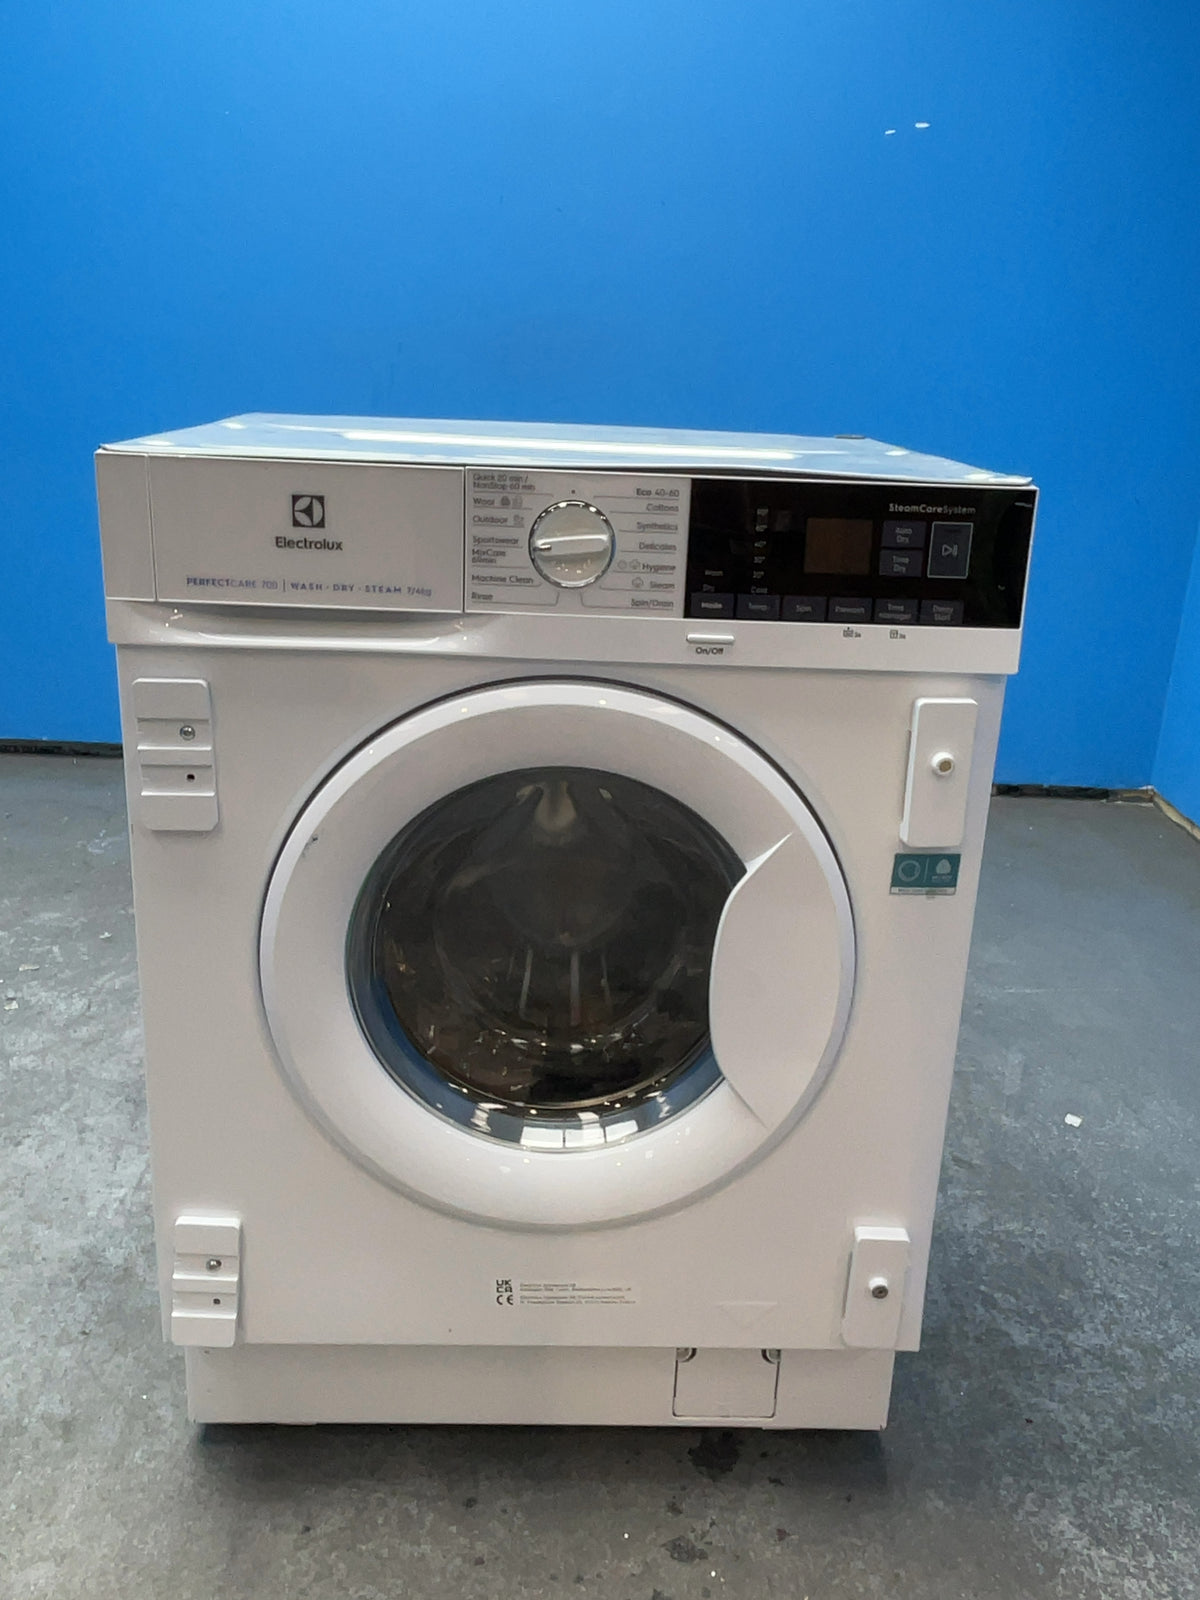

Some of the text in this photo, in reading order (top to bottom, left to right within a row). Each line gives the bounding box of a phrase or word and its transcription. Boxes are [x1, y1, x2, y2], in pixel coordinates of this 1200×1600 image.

[636, 488, 679, 497] Eco 40-60
[473, 497, 495, 506] Wool
[646, 504, 679, 512] Cottons
[889, 503, 976, 515] SteamCareSystem
[473, 515, 508, 523] Outdoor
[637, 522, 678, 531] Synthetics
[275, 536, 343, 551] Electrolux
[473, 536, 519, 545] Sportswear
[639, 542, 676, 551] Delicates
[642, 564, 675, 573] Hygiene
[509, 576, 533, 584] Clean
[186, 577, 256, 588] PERFECTCARE
[290, 582, 322, 591] WASH
[333, 583, 354, 592] DRY
[365, 584, 402, 594] STEAM
[650, 581, 675, 589] Steam
[631, 599, 673, 608] Spin/Drain
[696, 647, 724, 655] On/Off
